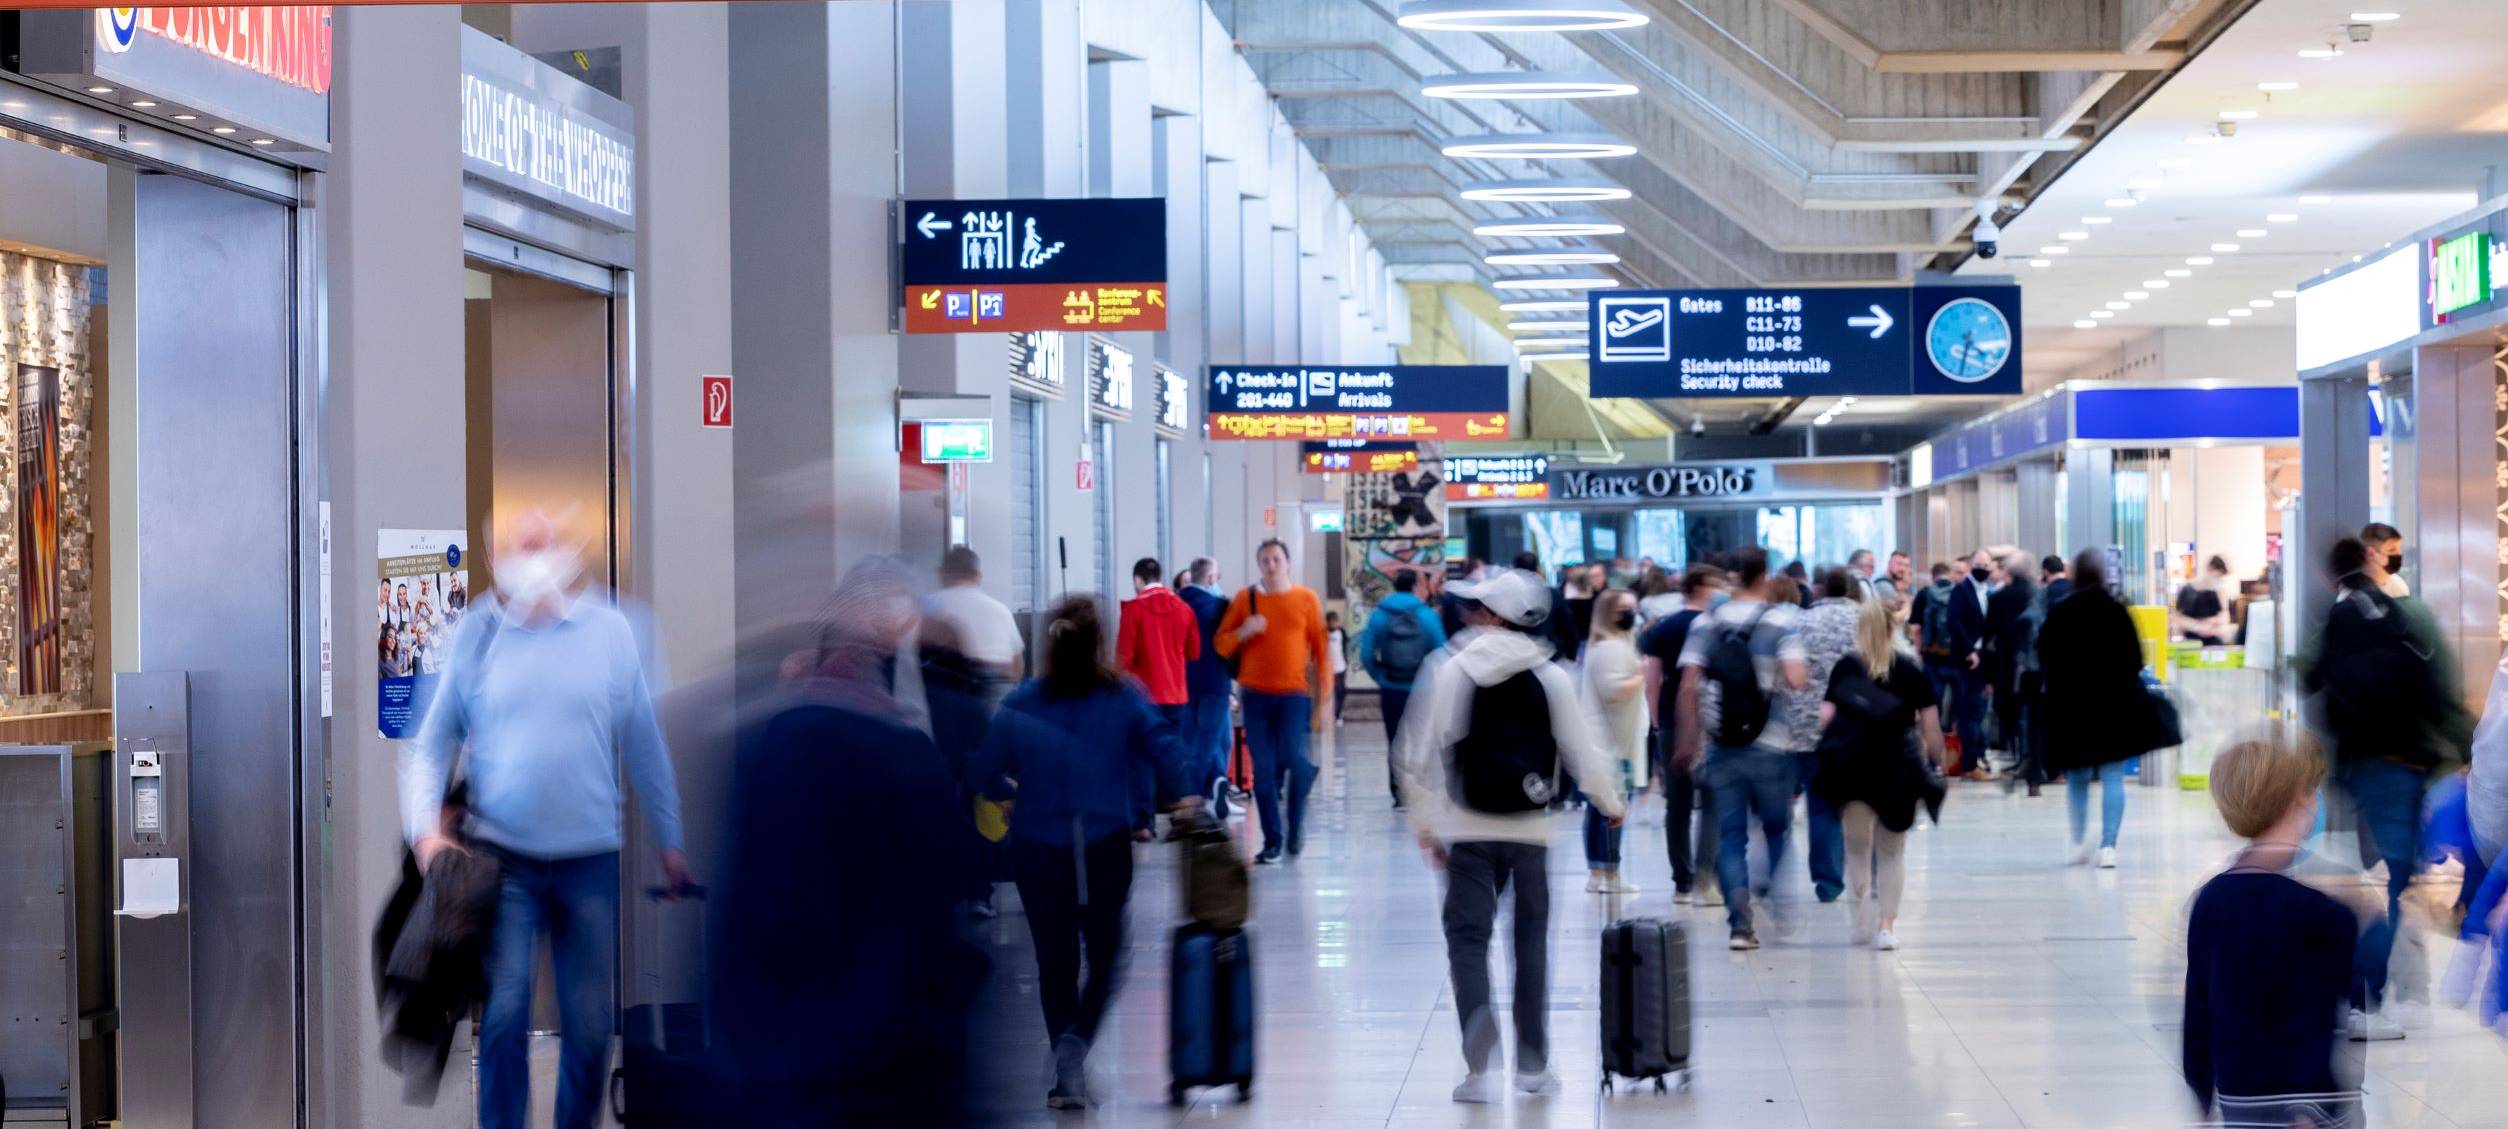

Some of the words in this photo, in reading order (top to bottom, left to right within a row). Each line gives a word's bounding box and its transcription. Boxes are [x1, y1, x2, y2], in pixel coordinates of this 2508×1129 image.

[1680, 297, 1723, 313] Gates
[1746, 316, 1802, 332] C11-73
[1746, 336, 1803, 352] D10-82
[1681, 357, 1831, 373] Sicherheitskontrolle
[1236, 372, 1298, 388] Check-in
[1338, 372, 1394, 388] Ankunft
[1681, 374, 1740, 391] Security
[1742, 374, 1784, 389] check
[1338, 392, 1392, 408] Arrivals
[1562, 470, 1639, 498] Marc
